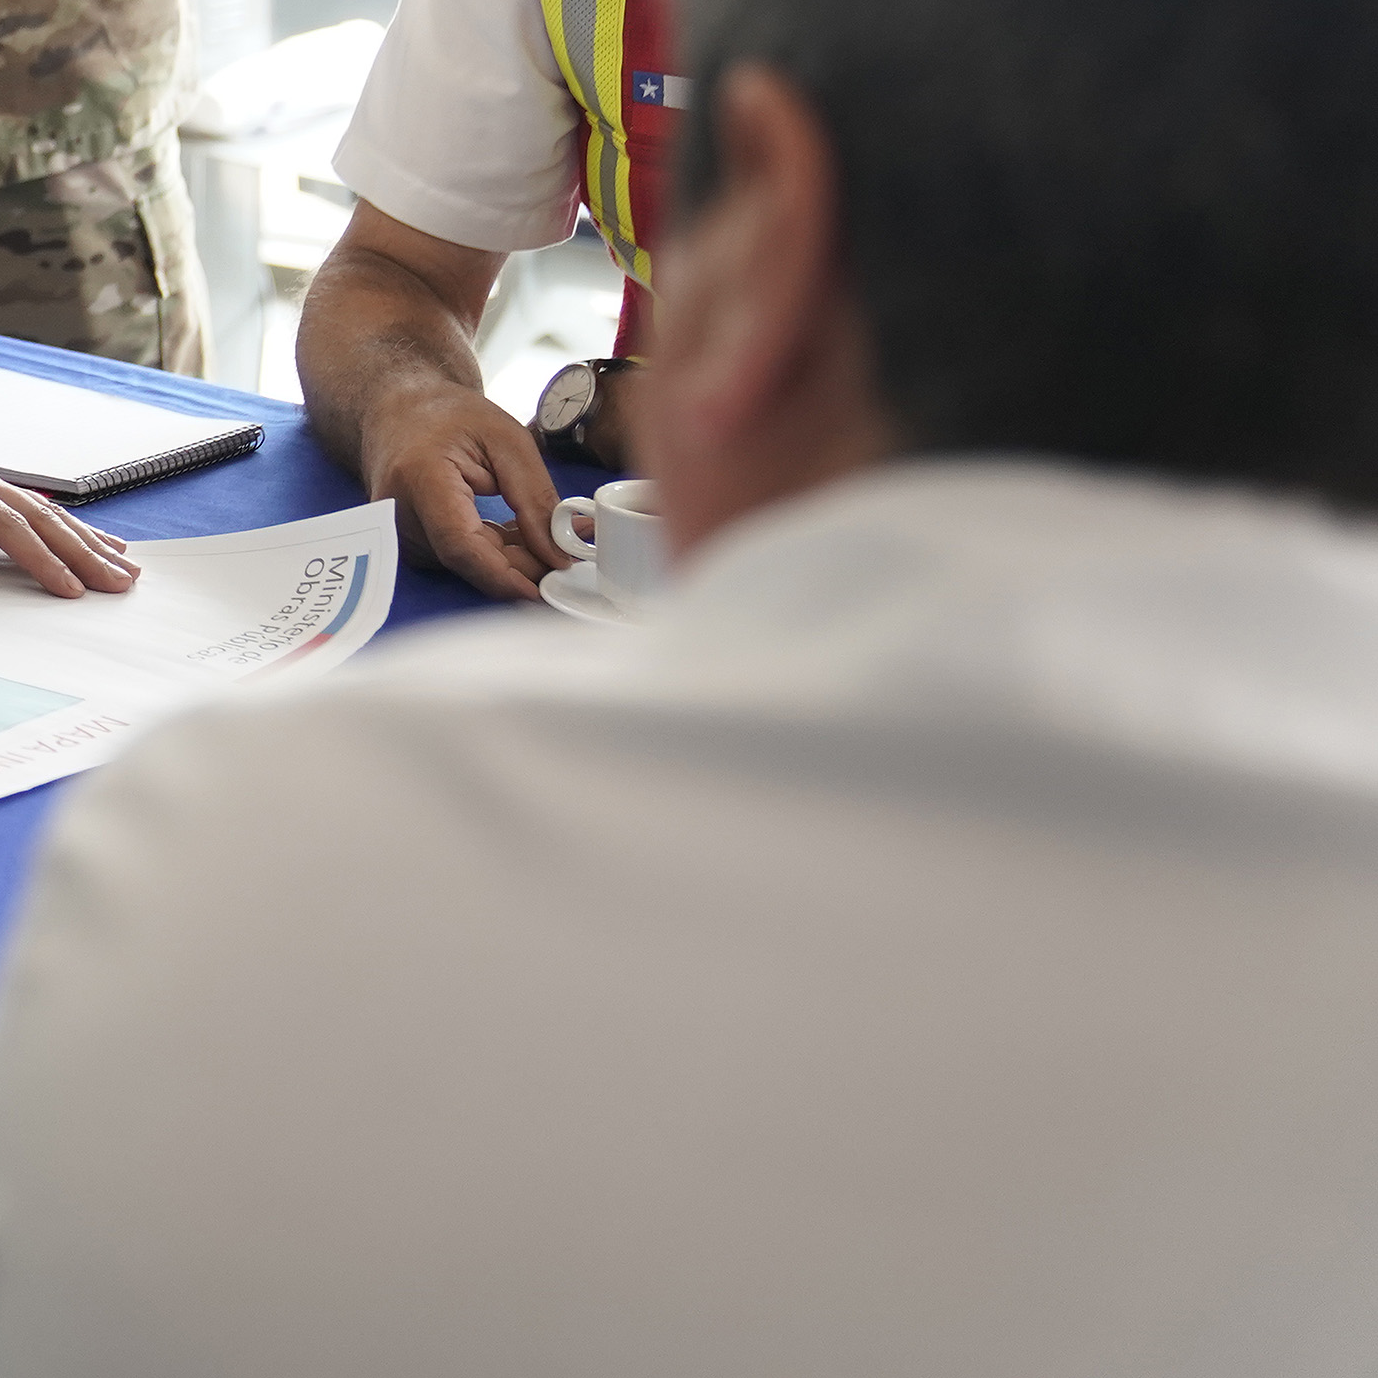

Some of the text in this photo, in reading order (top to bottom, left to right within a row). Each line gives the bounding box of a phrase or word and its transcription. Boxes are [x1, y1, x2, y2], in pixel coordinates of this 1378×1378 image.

[187, 557, 325, 661] Obras Públicas
[228, 555, 349, 664] Ministerio de
[21, 715, 131, 753] MAPA
